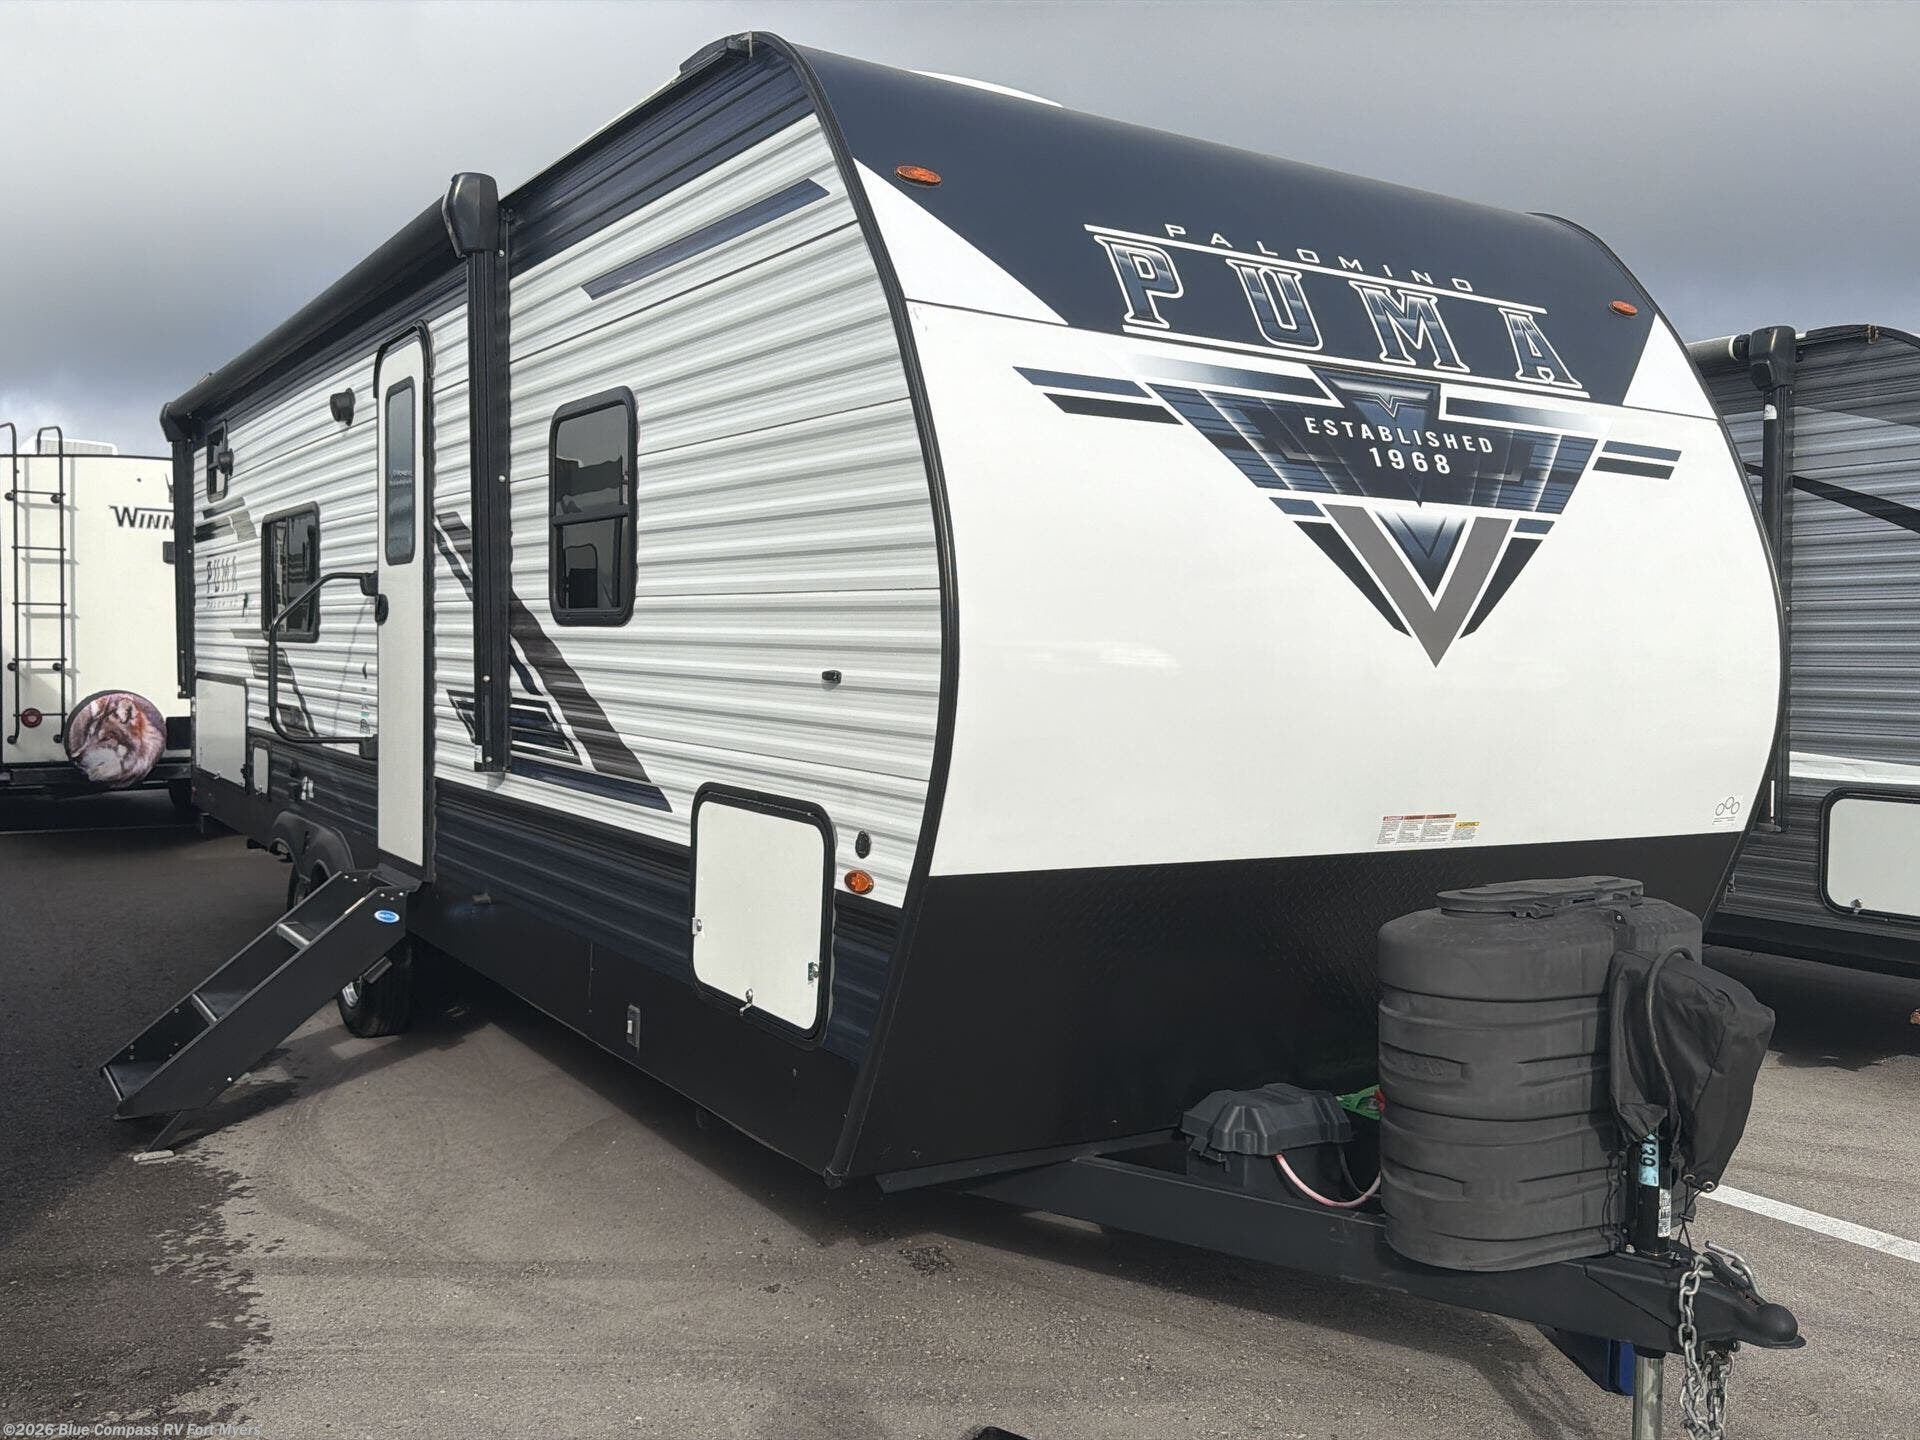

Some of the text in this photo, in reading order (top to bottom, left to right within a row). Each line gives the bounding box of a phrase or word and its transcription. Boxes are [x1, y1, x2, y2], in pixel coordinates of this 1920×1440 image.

[1163, 223, 1474, 293] PALOMINO
[1092, 233, 1583, 390] PUMA
[1303, 416, 1494, 454] ESTABLISHED
[1368, 446, 1451, 475] 1968
